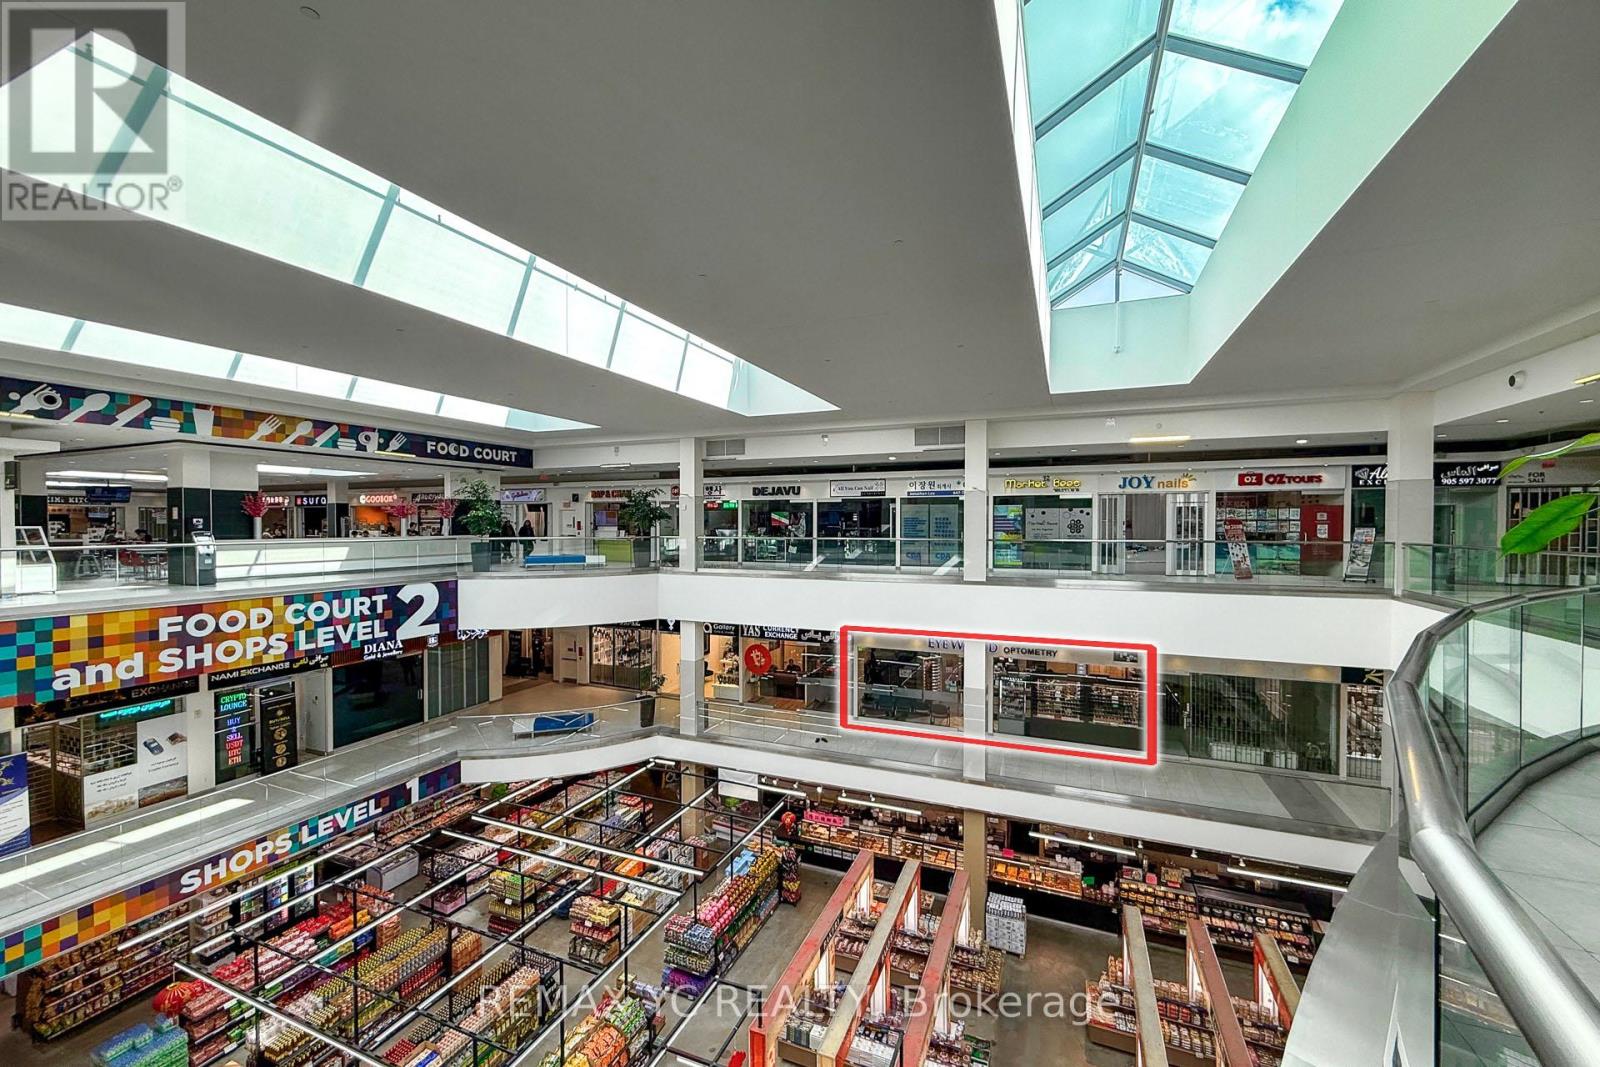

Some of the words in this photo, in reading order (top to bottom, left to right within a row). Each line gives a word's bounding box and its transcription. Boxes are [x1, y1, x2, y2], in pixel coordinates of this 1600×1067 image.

[427, 440, 469, 457] FOOD
[473, 447, 518, 462] COURT
[1441, 477, 1457, 485] 905
[1458, 477, 1475, 485] 597
[1477, 477, 1497, 485] 3077
[1528, 471, 1546, 479] FOR
[1118, 475, 1155, 489] JOY
[1157, 478, 1188, 489] nails
[752, 485, 801, 497] DEJAVU
[396, 582, 440, 641] 2
[158, 607, 274, 642] FOOD
[285, 594, 388, 625] COURT
[742, 625, 761, 637] YAS
[764, 631, 798, 639] EXCHANGE
[363, 639, 403, 655] DIANA
[1003, 646, 1057, 658] OPTOMETRY
[52, 652, 145, 691] and
[159, 632, 290, 671] SHOPS
[298, 619, 389, 651] LEVEL
[211, 671, 239, 682] NAMI
[240, 661, 290, 677] EXCHANGE
[220, 692, 247, 704] CRYPTO
[220, 699, 247, 711] LOUNGE
[227, 716, 242, 726] BUY
[226, 732, 244, 742] SELL
[226, 740, 245, 750] USDT
[180, 833, 293, 894] SHOPS
[302, 798, 384, 845] LEVEL
[405, 777, 421, 806] 1
